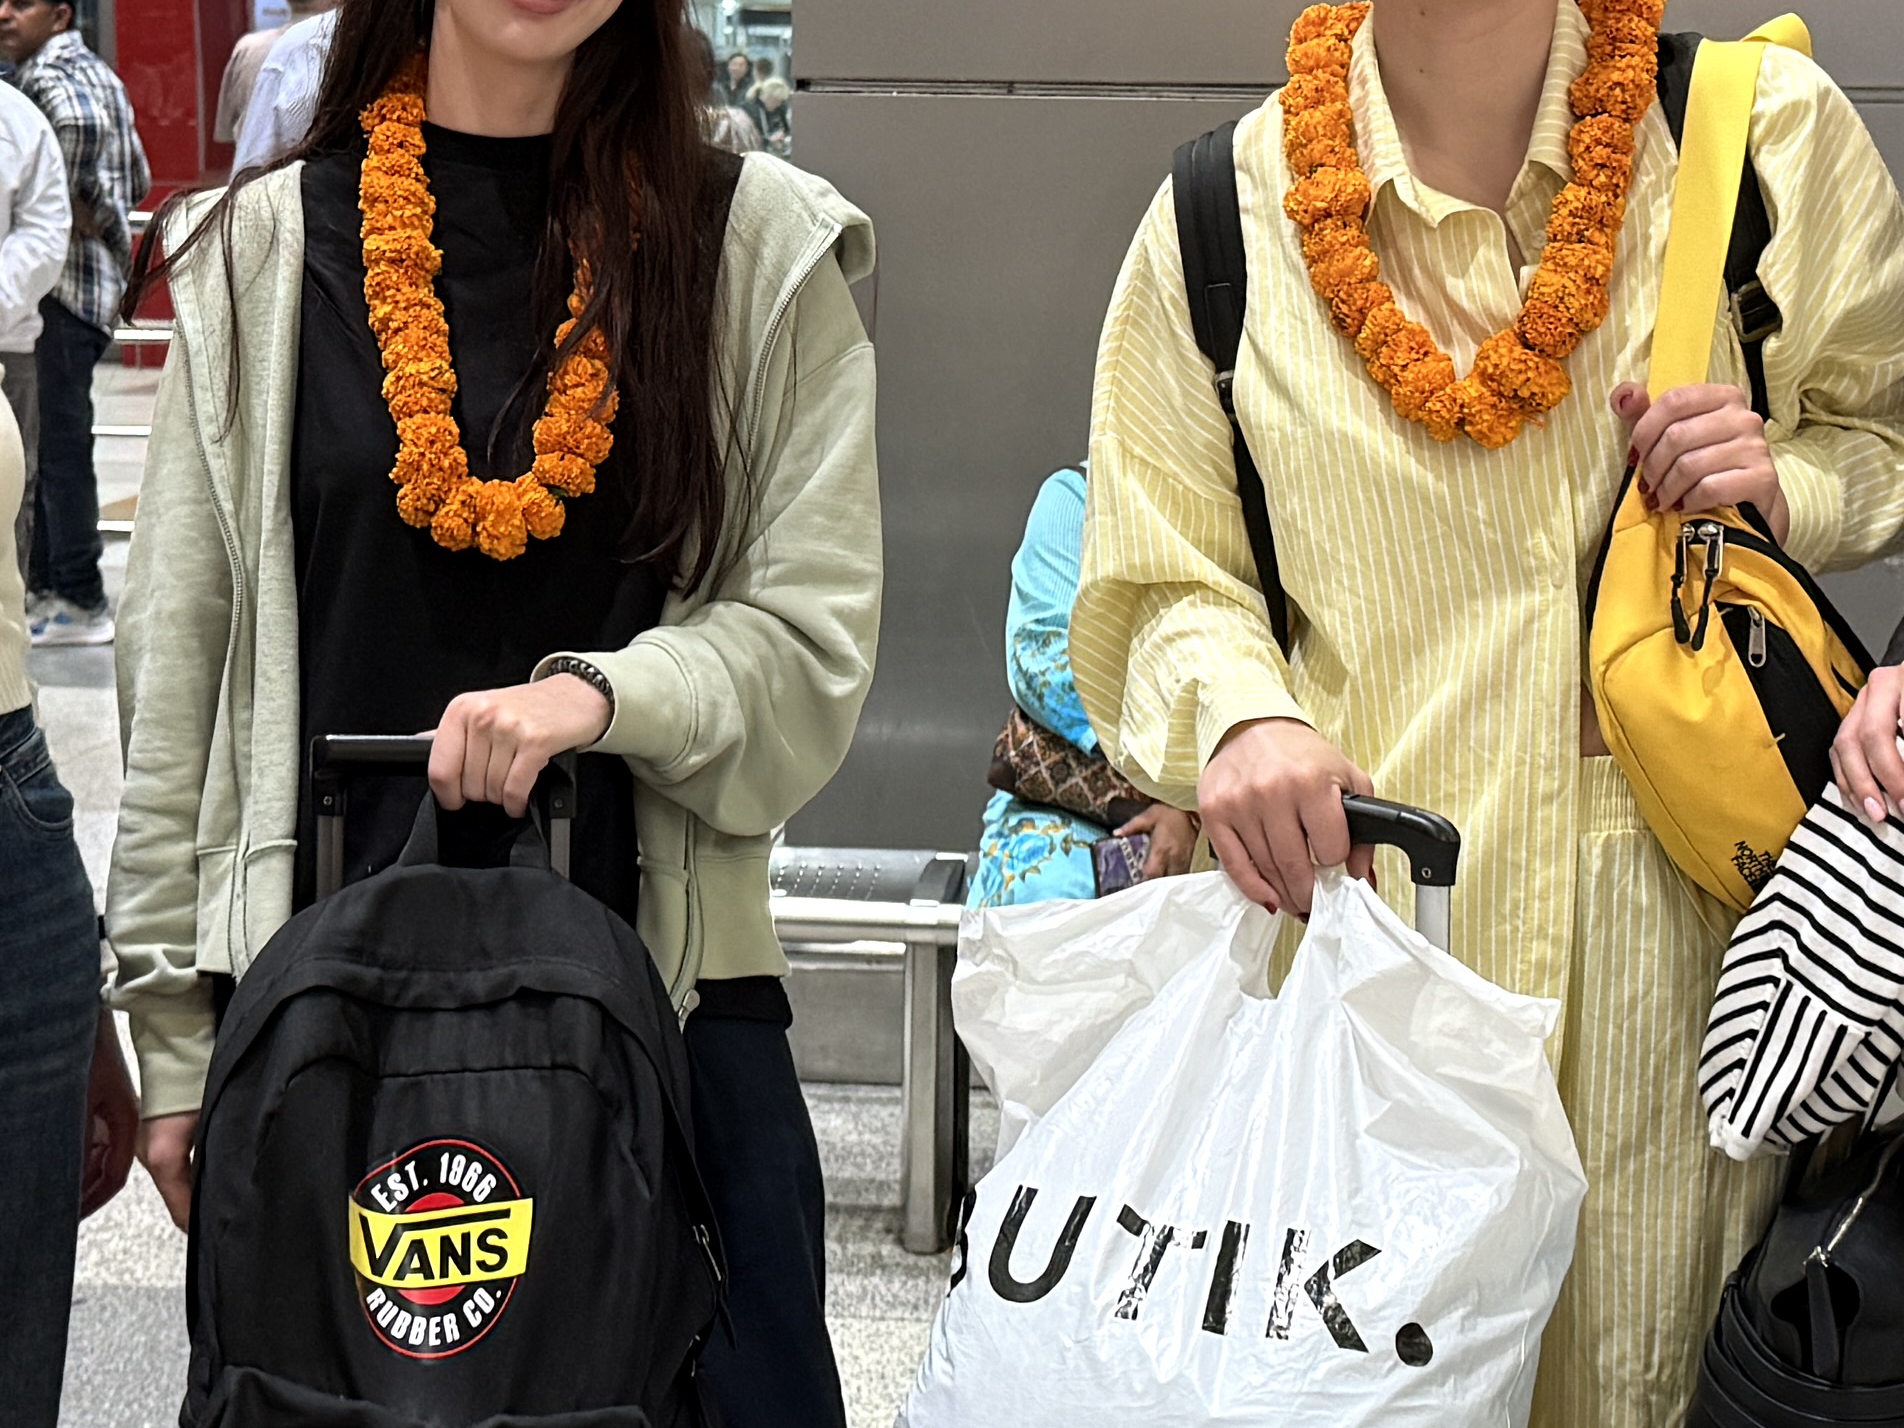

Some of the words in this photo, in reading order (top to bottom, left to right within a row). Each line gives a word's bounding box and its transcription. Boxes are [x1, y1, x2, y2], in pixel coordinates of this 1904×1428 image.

[370, 1160, 428, 1213] EST.
[439, 1151, 497, 1203] 1966
[358, 1207, 511, 1282] VANS
[947, 1183, 1434, 1367] UTIK.
[366, 1287, 460, 1347] RUBBER
[462, 1287, 502, 1329] CO.
